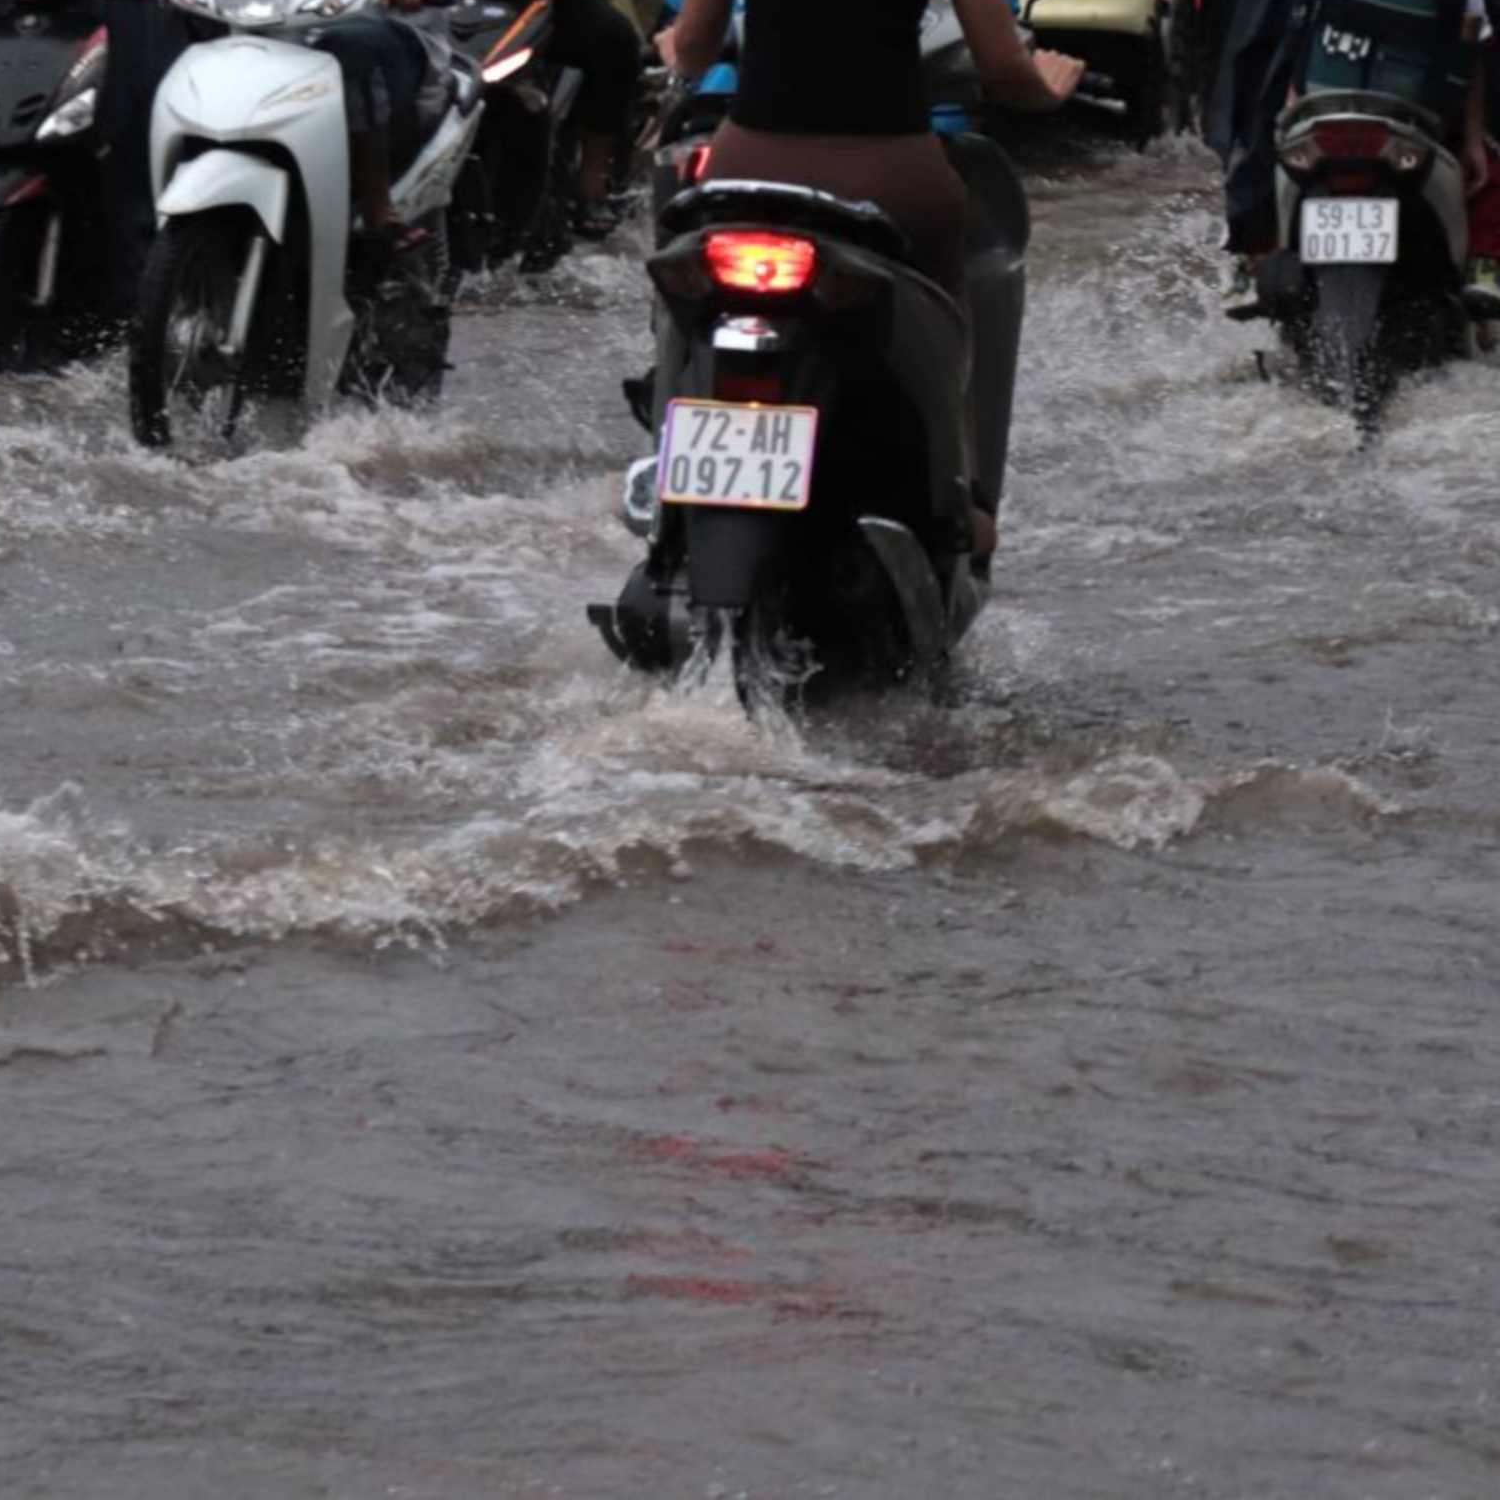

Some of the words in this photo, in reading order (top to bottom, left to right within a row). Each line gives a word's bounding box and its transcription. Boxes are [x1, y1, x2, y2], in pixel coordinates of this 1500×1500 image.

[1316, 202, 1384, 230] 59-L3
[1307, 232, 1390, 259] 001.37
[689, 409, 792, 455] 72-AH
[669, 454, 802, 501] 097.12
